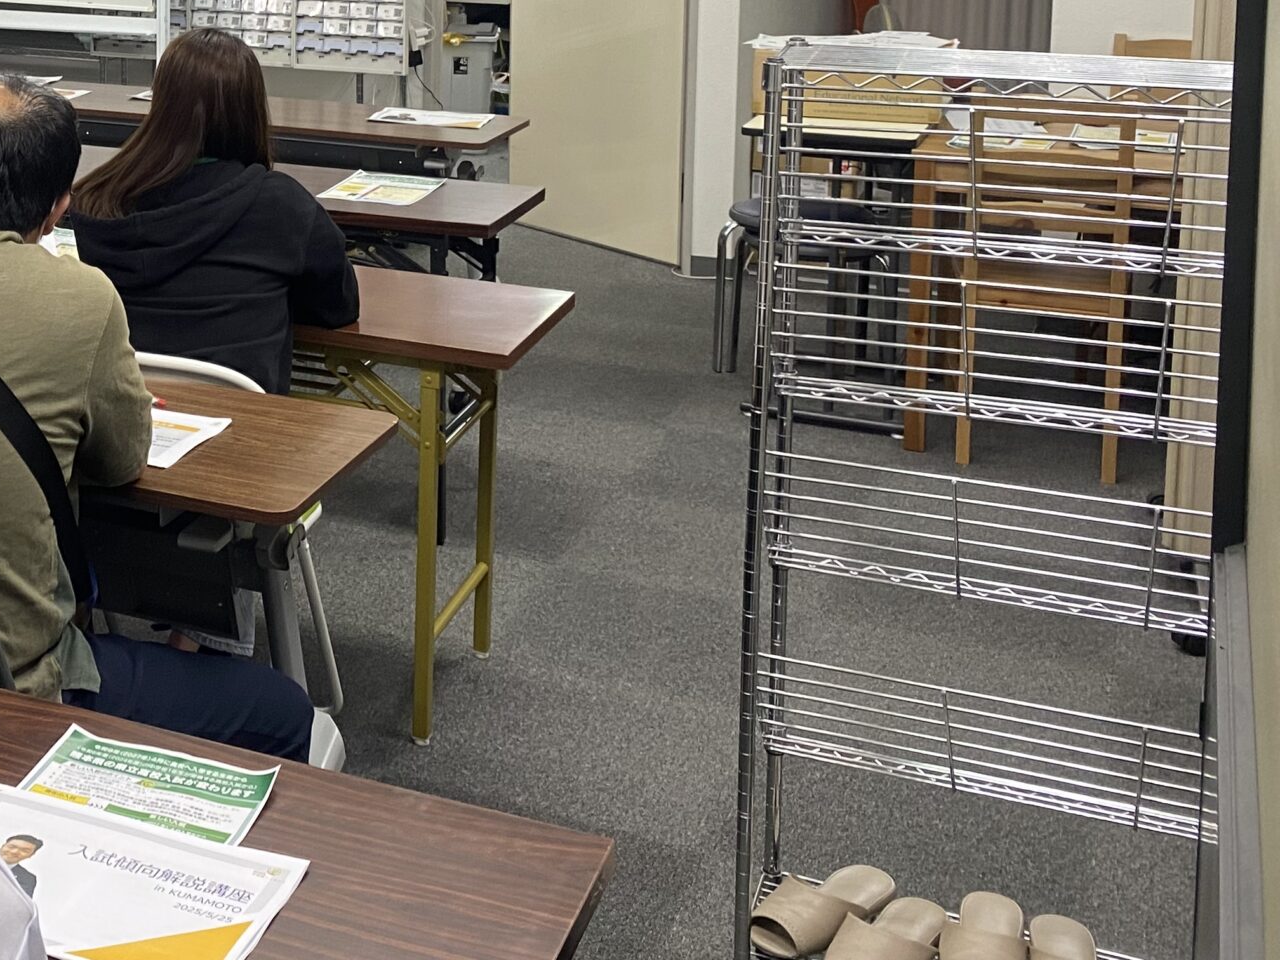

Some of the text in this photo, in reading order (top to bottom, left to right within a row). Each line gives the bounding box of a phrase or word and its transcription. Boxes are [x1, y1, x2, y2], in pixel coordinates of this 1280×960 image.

[68, 844, 255, 905] 入試傾向解説講座
[153, 884, 243, 914] in KUMAMOTO
[173, 902, 234, 924] 2025/5/25
